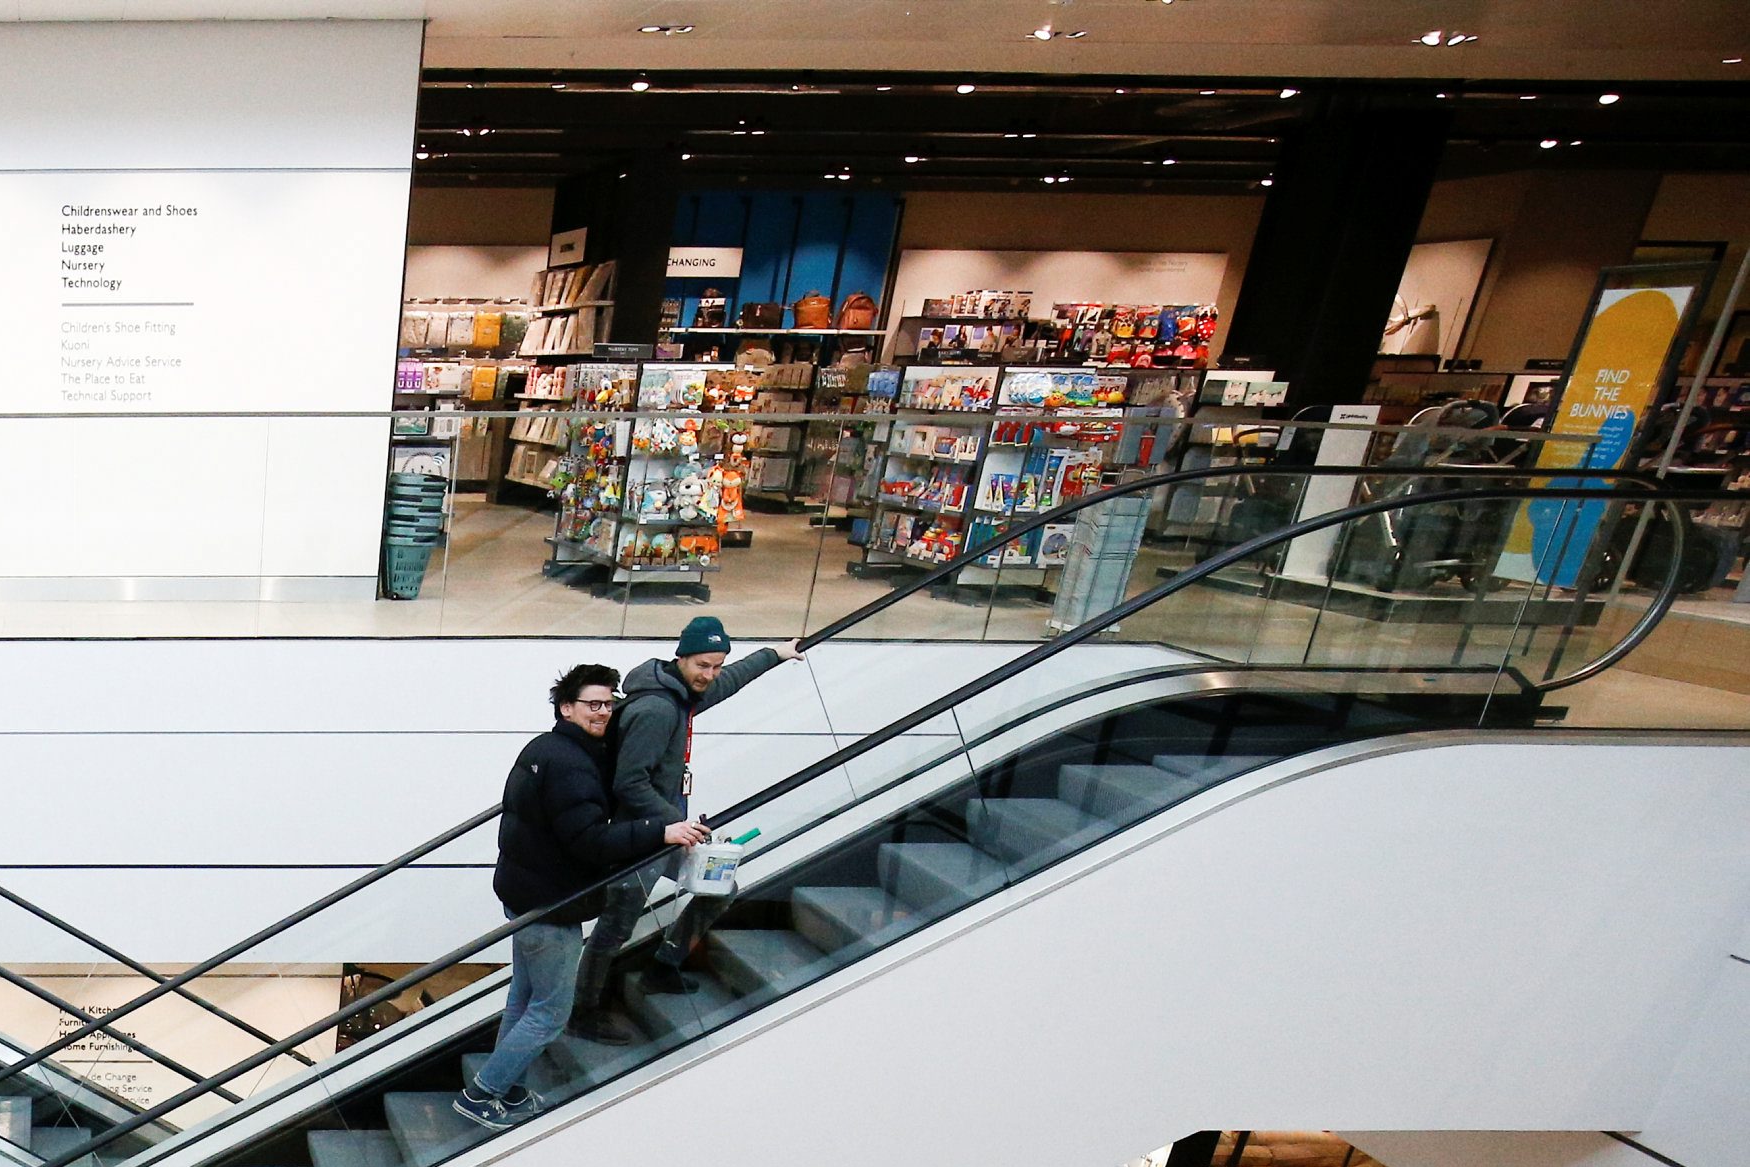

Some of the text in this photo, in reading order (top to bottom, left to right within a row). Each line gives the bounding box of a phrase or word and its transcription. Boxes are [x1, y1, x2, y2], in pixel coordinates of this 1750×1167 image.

[61, 204, 198, 217] Childrenswear and Shoes
[61, 223, 137, 238] Haberdashery
[61, 241, 104, 256] Luggage
[61, 259, 105, 273] Nursery
[61, 277, 122, 291] Technology
[61, 321, 176, 336] Children's Shoe Fitting
[61, 339, 90, 351] Kuoni
[61, 355, 182, 370] Nursery Advice Service
[61, 373, 146, 384] The Place to Eat
[1595, 368, 1631, 384] FIND
[61, 390, 152, 402] Technical Support
[1593, 386, 1622, 402] THE
[1570, 403, 1631, 419] BUNNIES
[88, 1005, 117, 1014] Kitch
[59, 1018, 87, 1027] Furnit
[63, 1042, 135, 1053] ome Furnishing
[104, 1072, 137, 1083] Change
[122, 1084, 153, 1094] Service
